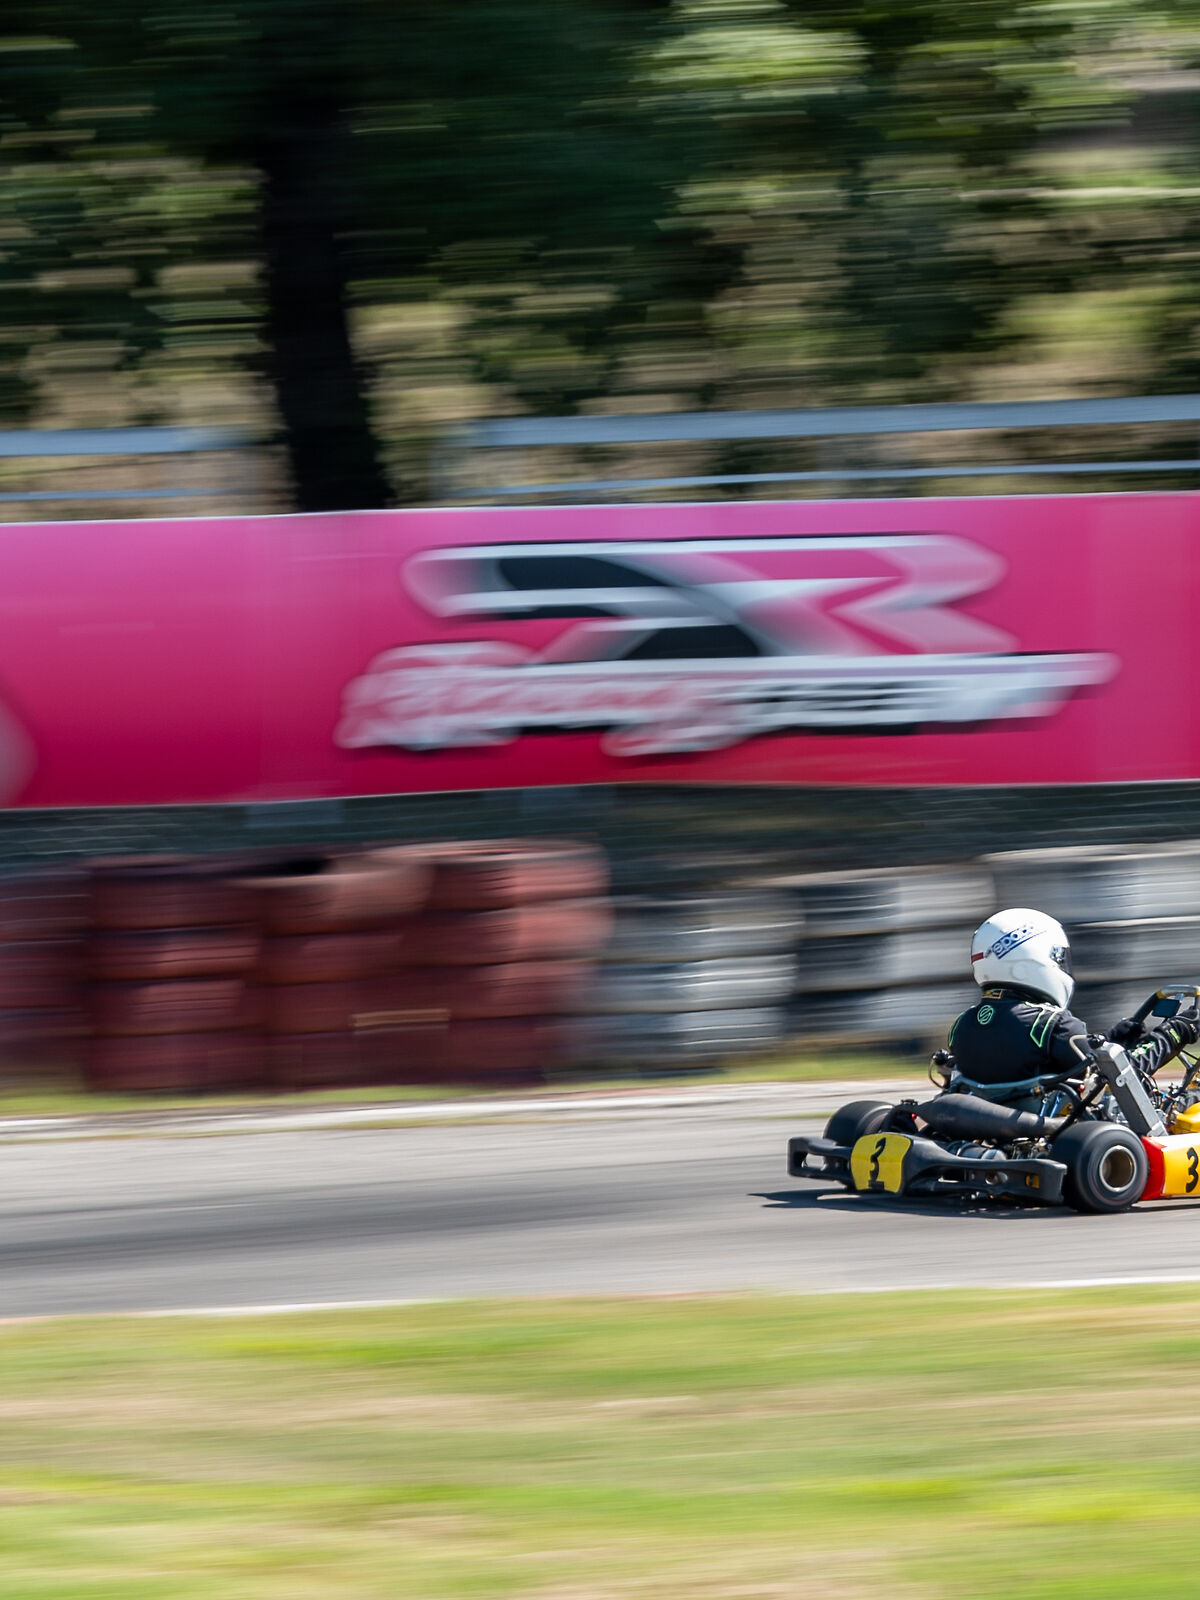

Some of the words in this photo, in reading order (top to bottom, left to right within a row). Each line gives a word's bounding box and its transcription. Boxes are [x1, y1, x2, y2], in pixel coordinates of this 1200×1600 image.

[991, 923, 1036, 956] spaco
[869, 1137, 887, 1182] 3
[1185, 1147, 1199, 1193] 3
